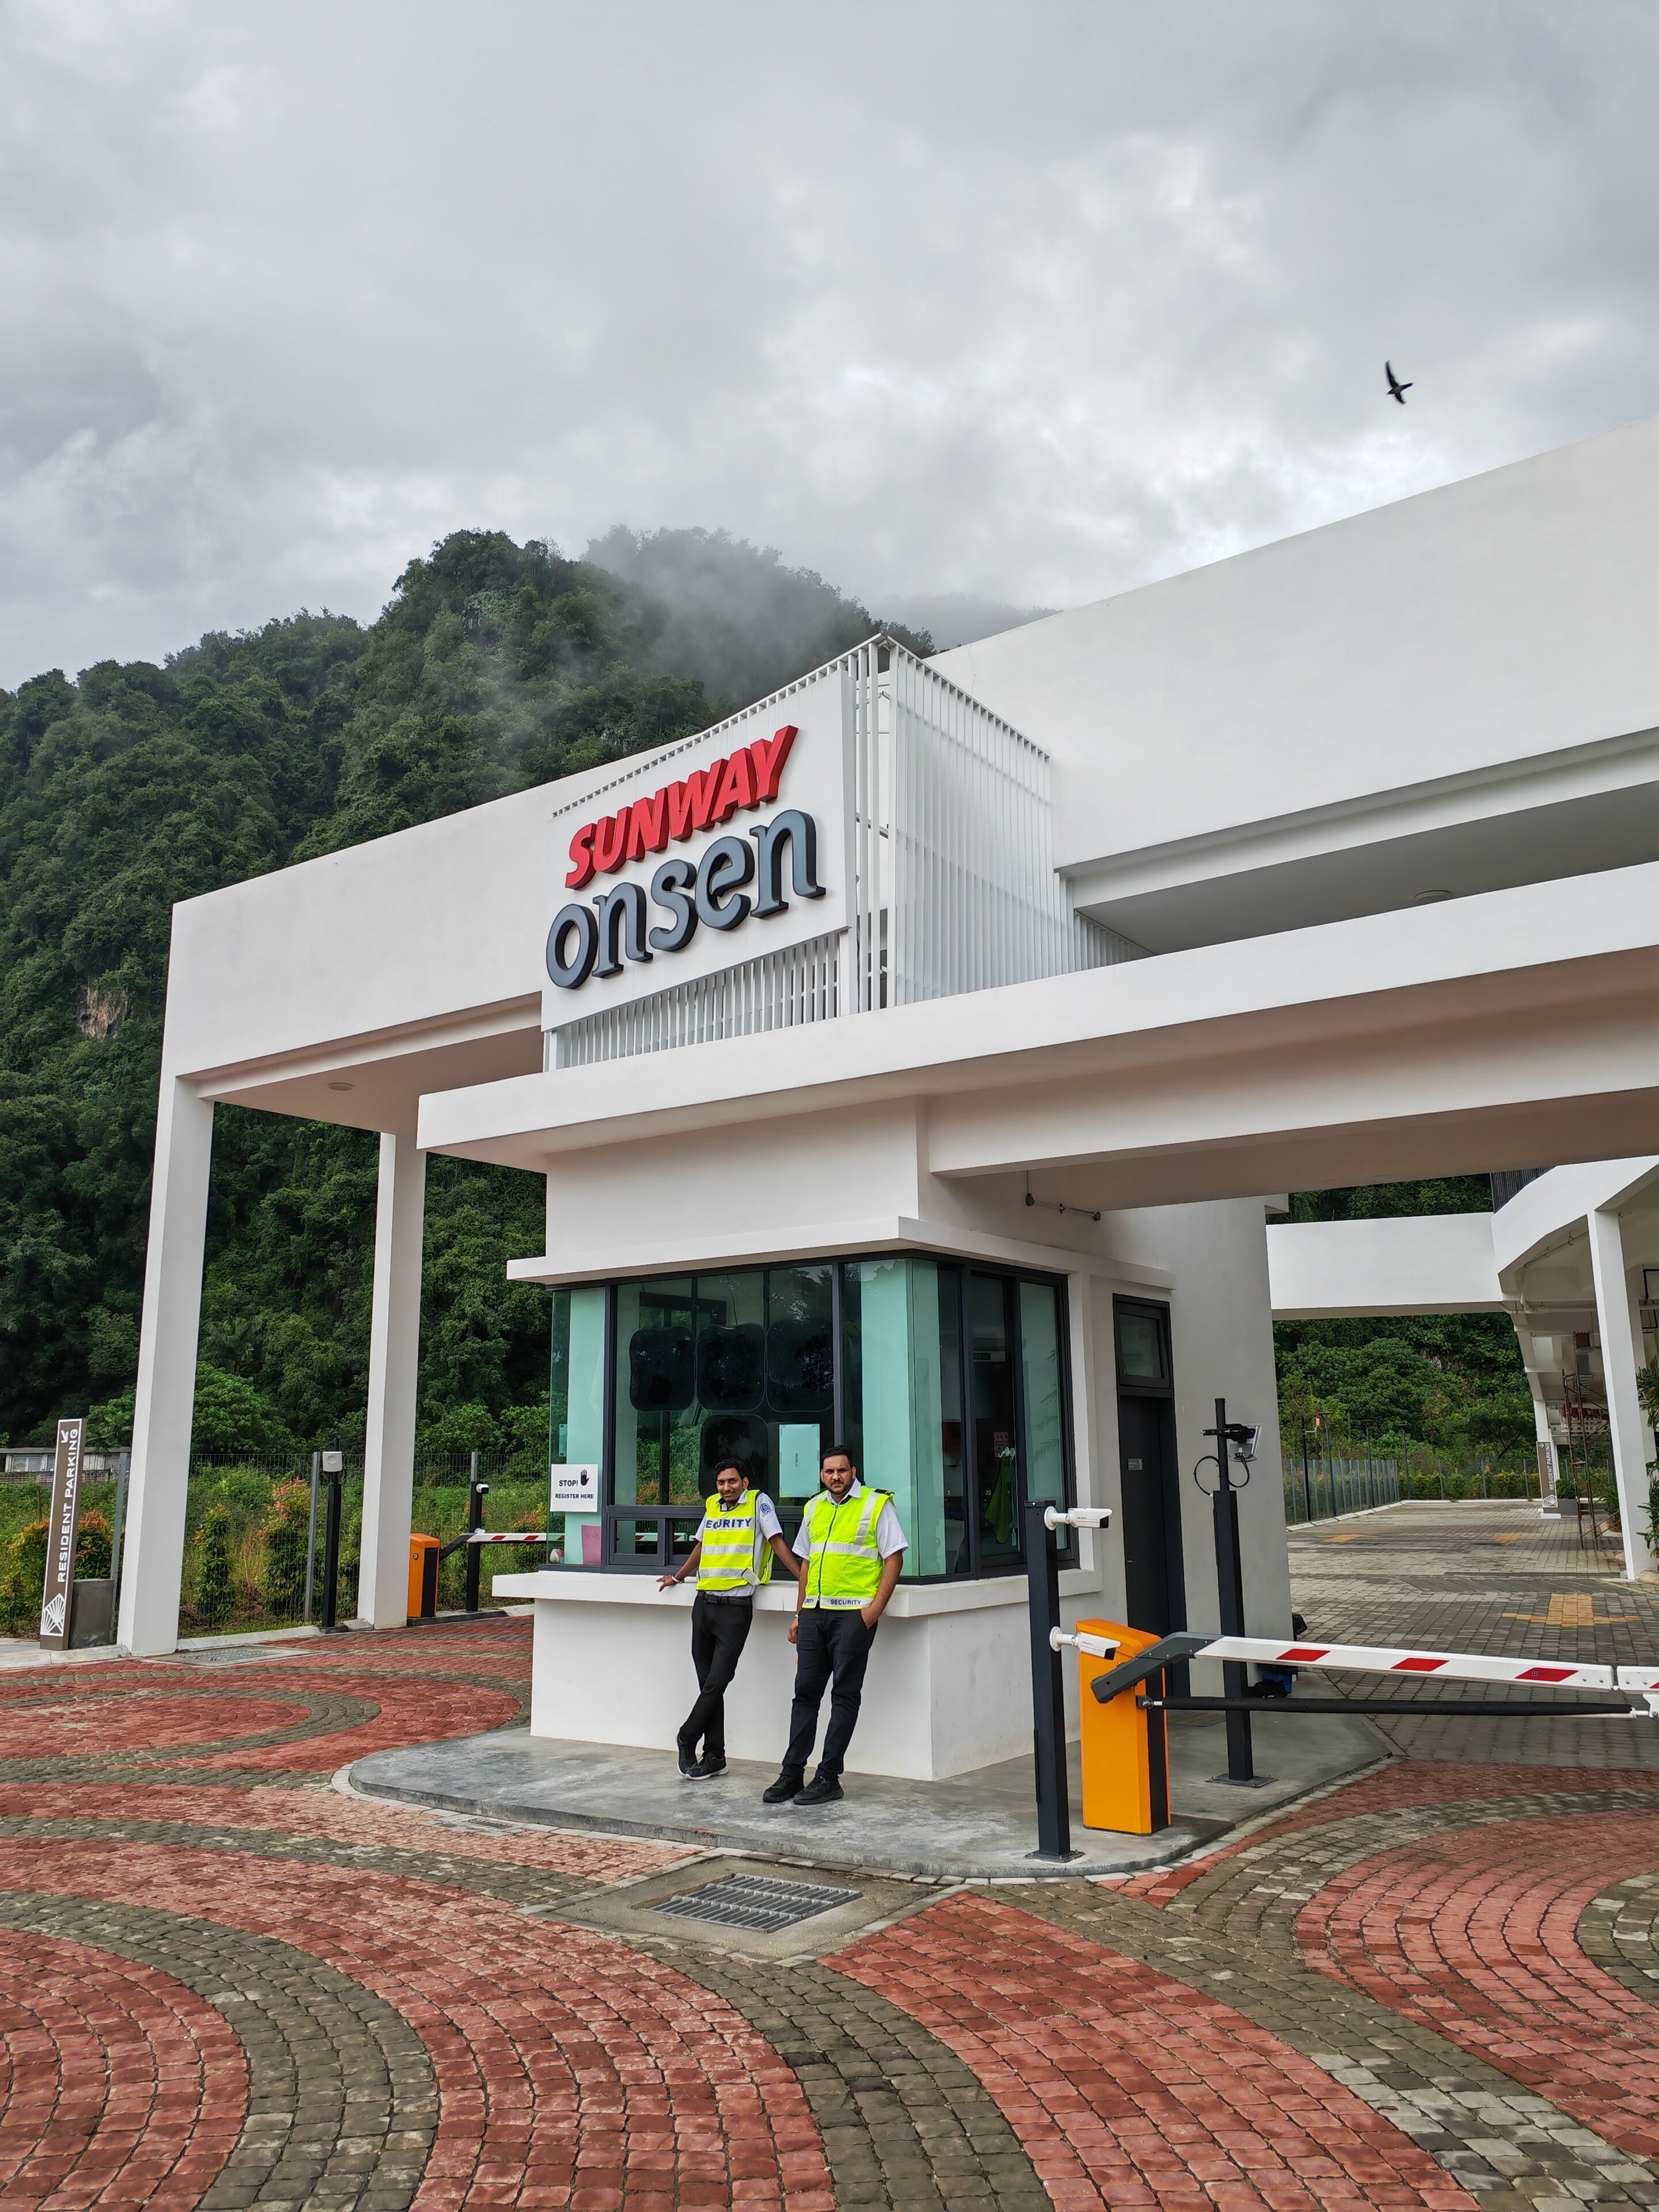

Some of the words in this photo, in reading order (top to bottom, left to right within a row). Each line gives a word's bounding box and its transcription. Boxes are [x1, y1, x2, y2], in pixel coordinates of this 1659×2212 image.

[565, 725, 798, 889] SUNWAY
[546, 809, 826, 989] onsen
[57, 1503, 72, 1583] RESIDENT
[65, 1429, 78, 1498] PARKING
[706, 1518, 752, 1529] ECURITY
